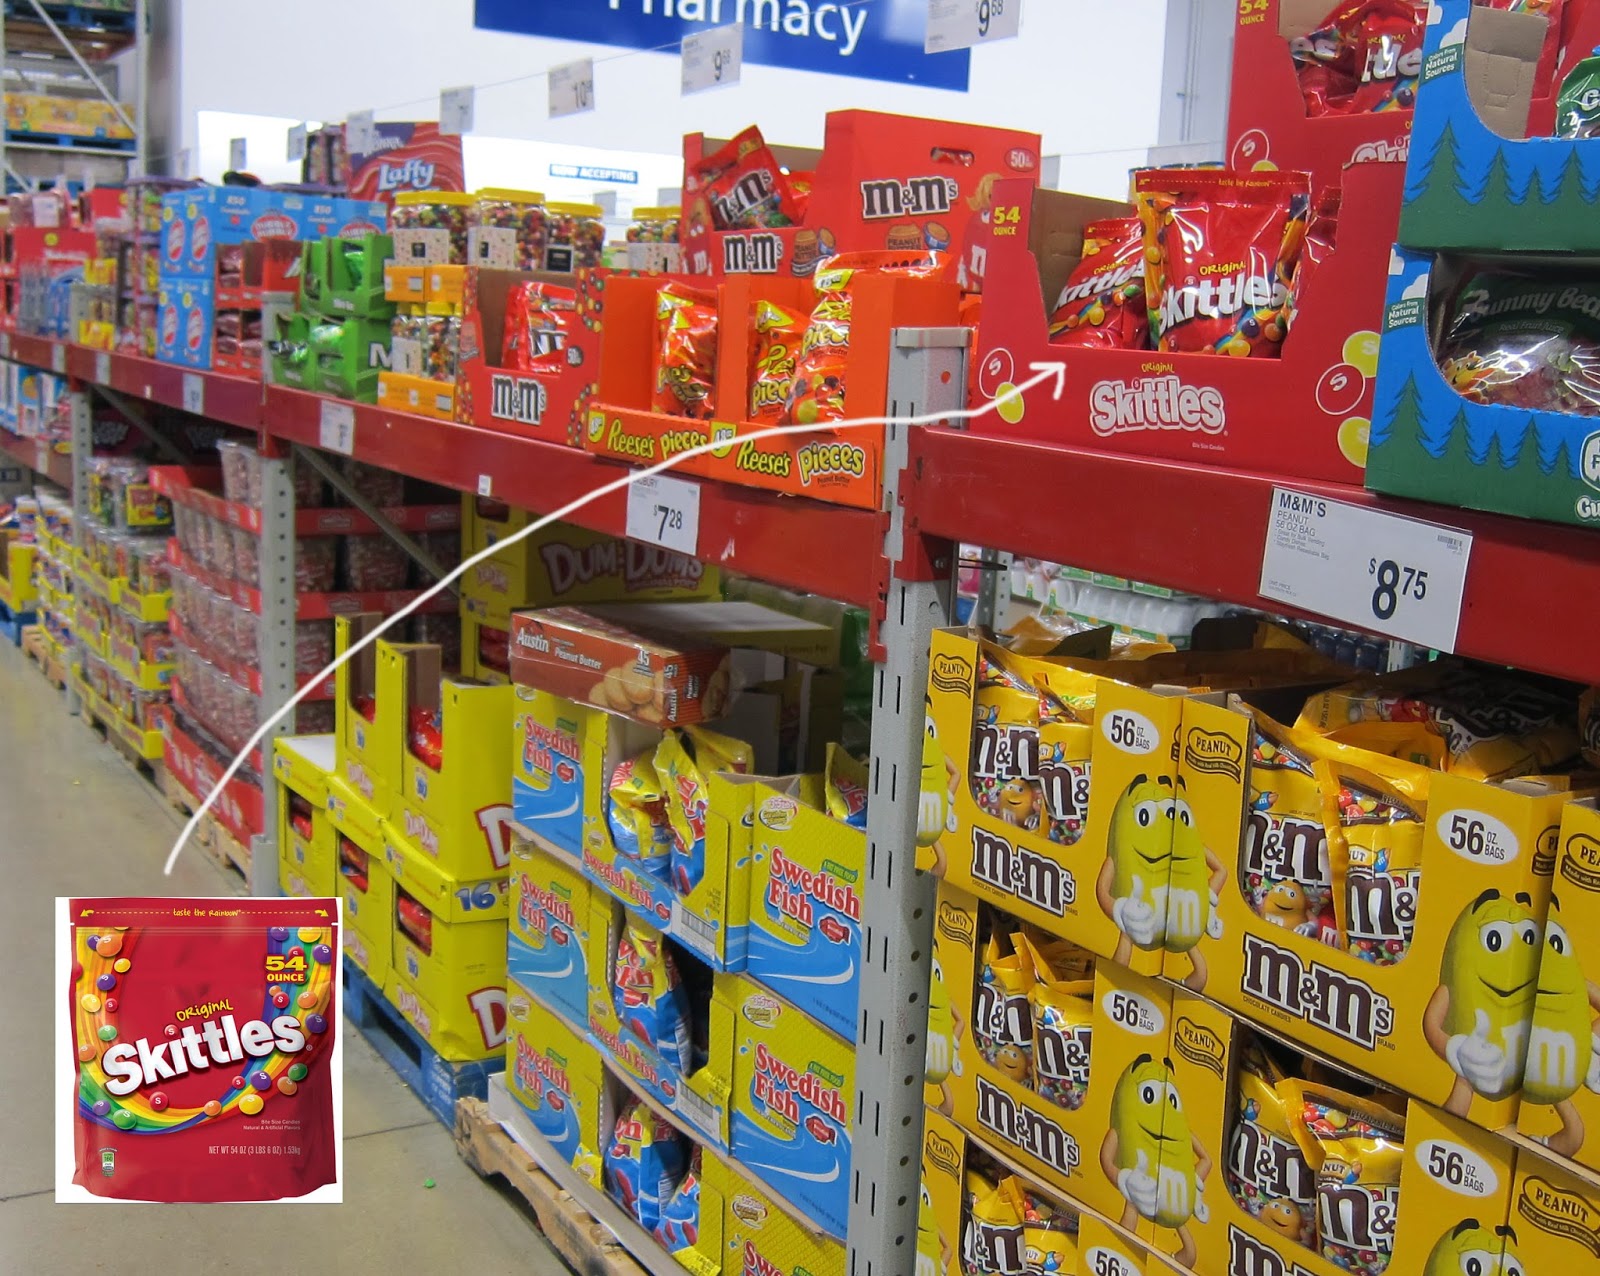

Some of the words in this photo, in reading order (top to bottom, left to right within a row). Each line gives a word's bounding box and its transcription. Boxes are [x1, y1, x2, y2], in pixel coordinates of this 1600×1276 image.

[608, 0, 867, 56] armacy
[1425, 52, 1458, 71] Natural
[1425, 64, 1455, 79] Sources
[378, 158, 435, 191] Laffy
[993, 206, 1021, 225] 54
[993, 226, 1017, 236] OUNCE
[1052, 258, 1145, 313] kittles
[1388, 305, 1419, 320] Natural
[1388, 317, 1417, 328] Sources
[1089, 375, 1226, 438] Skittles
[607, 418, 656, 459] Reese's
[736, 438, 792, 479] Reese's
[797, 441, 865, 487] pieces
[1277, 510, 1309, 526] PEANUT
[1279, 492, 1327, 518] M&M'S
[1275, 519, 1285, 529] 56
[1286, 522, 1298, 532] OZ
[1299, 525, 1316, 537] BAG
[516, 625, 549, 653] Austin
[554, 646, 578, 662] Peanut
[579, 652, 603, 670] Butter
[637, 648, 650, 666] 45
[939, 661, 965, 677] PEANUT
[1111, 714, 1136, 747] 56
[1135, 737, 1151, 750] BAGS
[1195, 735, 1232, 757] PEANUT
[1449, 814, 1485, 856] 56
[1484, 844, 1505, 861] BAGS
[455, 881, 496, 912] 16
[584, 848, 626, 891] Swedish
[629, 879, 654, 912] Fish
[769, 846, 861, 923] Swedish
[520, 896, 548, 935] Fish
[521, 872, 575, 931] Swedish
[768, 875, 814, 928] Fish
[1112, 993, 1139, 1027] 56
[1138, 1018, 1155, 1032] BAGS
[590, 1015, 631, 1064] Swedish
[634, 1054, 659, 1087] Fish
[1184, 1026, 1216, 1052] PEANUT
[1376, 1037, 1396, 1051] BRAND
[517, 1033, 572, 1098] Swedish
[517, 1055, 544, 1098] Fish
[754, 1042, 847, 1127] Swedish
[754, 1069, 800, 1125] Fish
[1322, 1162, 1346, 1175] NUT
[1428, 1143, 1464, 1185] 56
[1463, 1176, 1484, 1193] BAGS
[1535, 1187, 1589, 1223] PEANUT
[1095, 1249, 1120, 1276] 56
